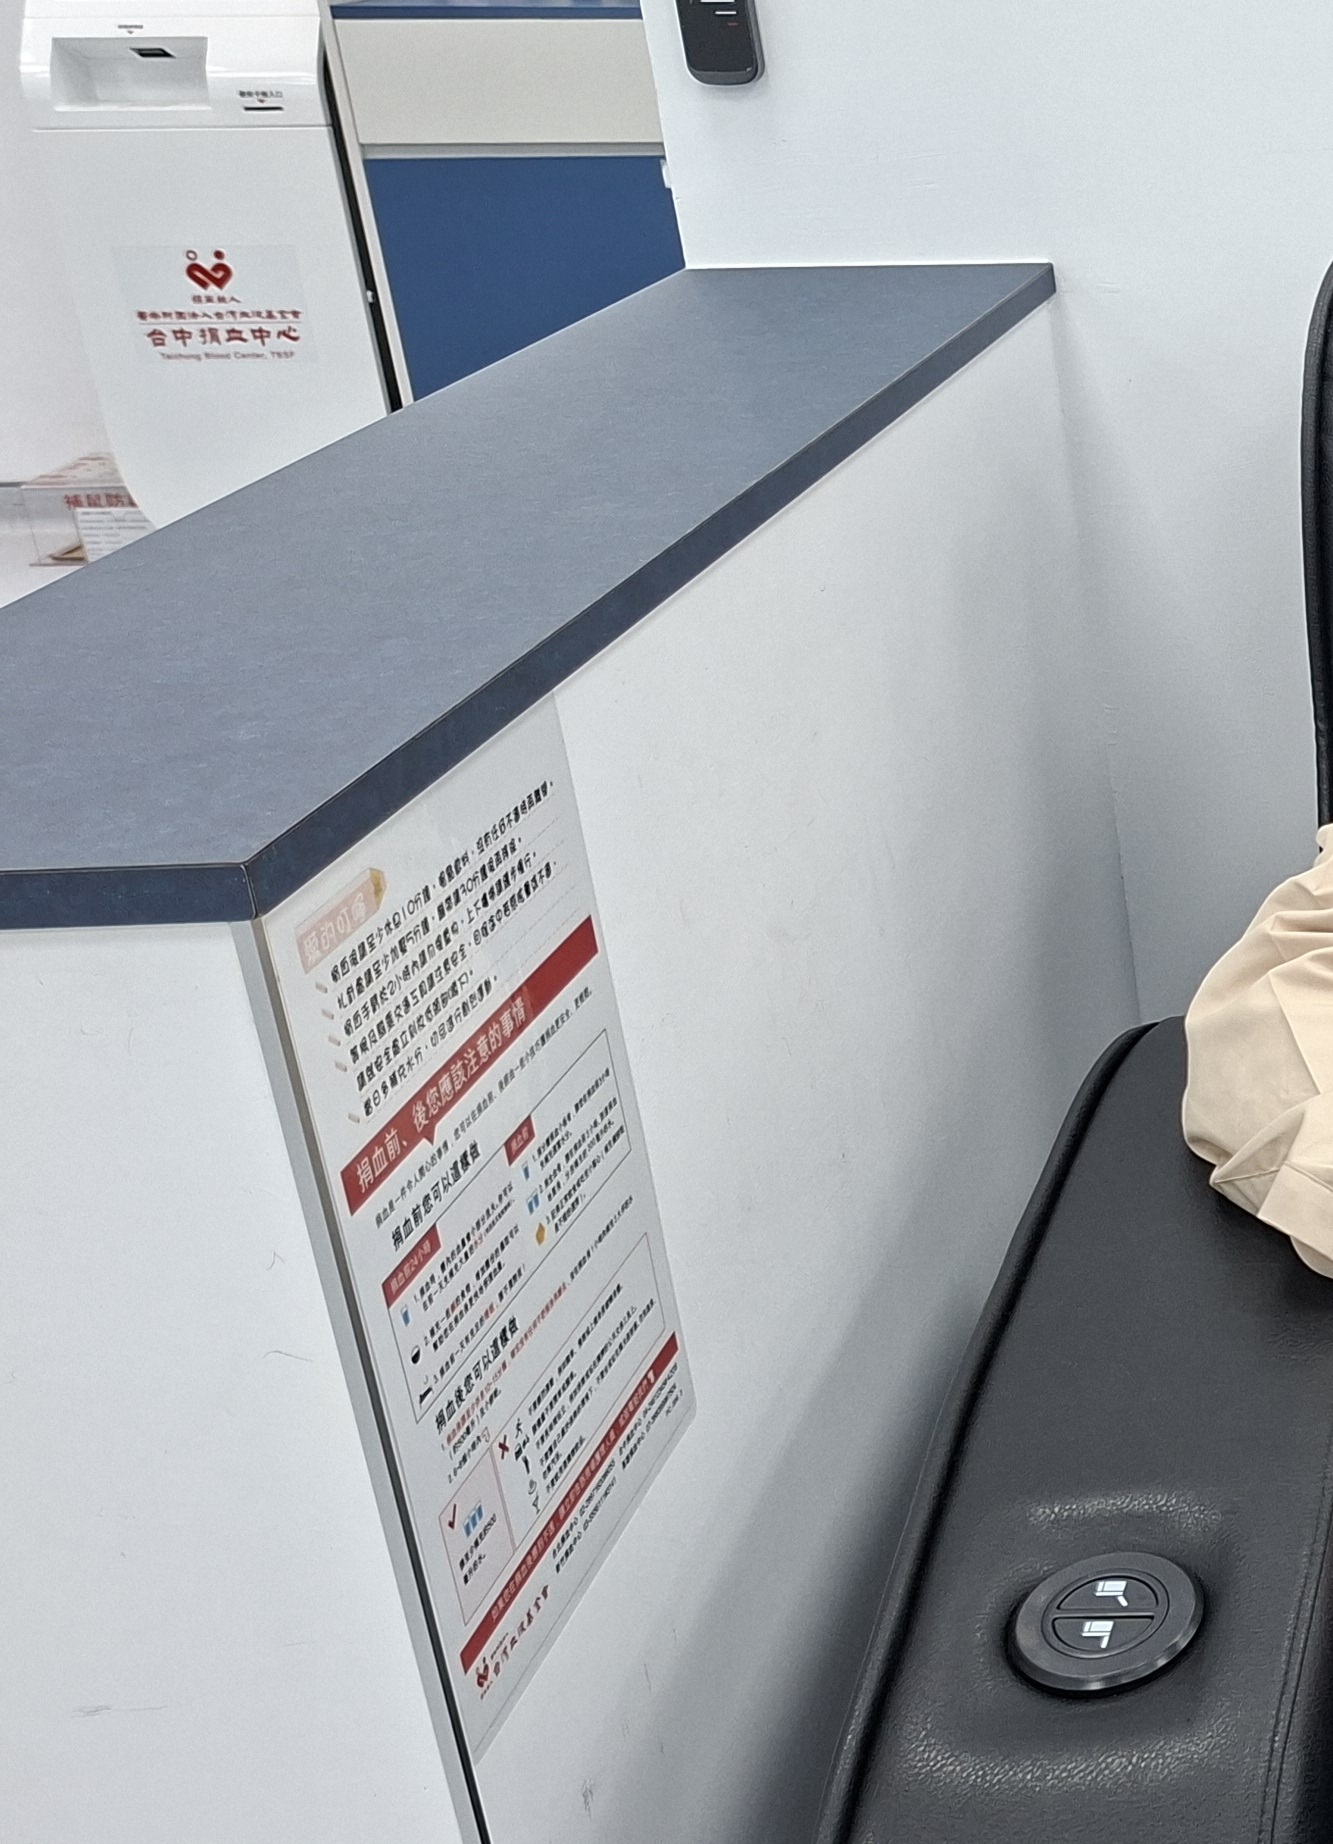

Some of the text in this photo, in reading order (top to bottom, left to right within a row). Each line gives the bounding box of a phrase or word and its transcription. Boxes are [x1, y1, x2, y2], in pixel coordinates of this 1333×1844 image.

[146, 325, 300, 348] 台中捐血中心
[301, 889, 368, 969] 愛的叮嚀
[354, 991, 527, 1196] 捐血前、後您應該注意的事情
[389, 1135, 481, 1253] 捐血前您可以這樣做
[433, 1311, 518, 1436] 捐血後您可以這樣做
